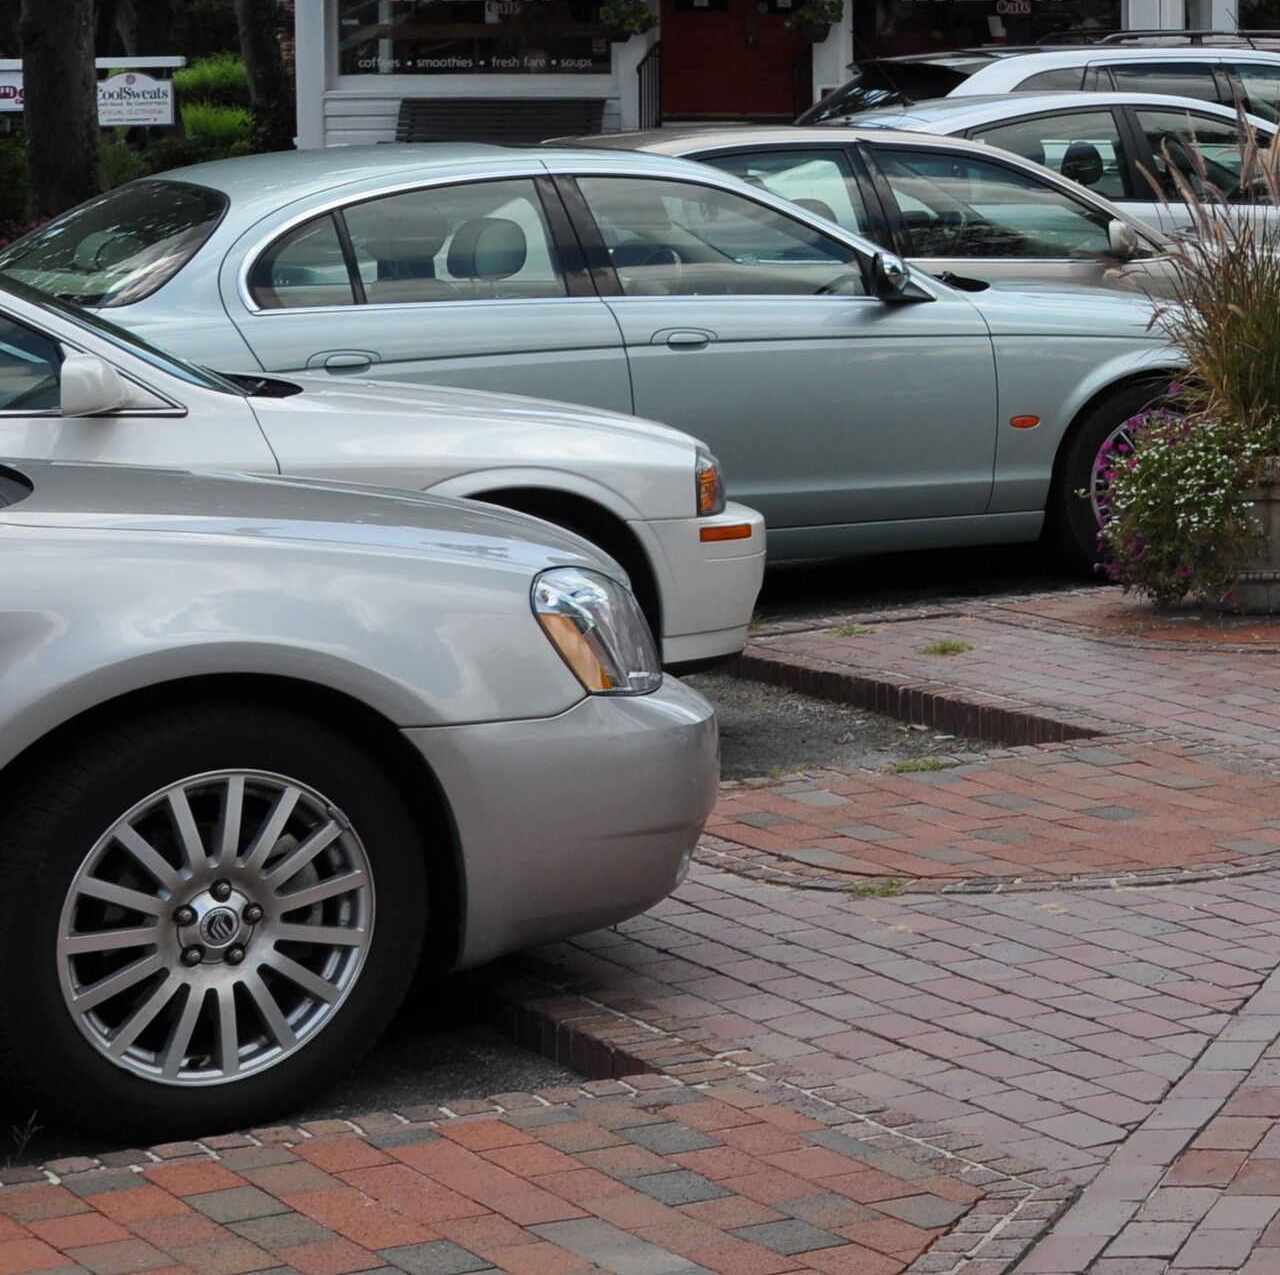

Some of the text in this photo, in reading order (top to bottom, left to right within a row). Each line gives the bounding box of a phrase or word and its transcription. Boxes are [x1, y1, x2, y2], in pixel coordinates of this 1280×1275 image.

[416, 56, 473, 68] smoothies
[491, 56, 519, 68] fresh
[523, 56, 546, 68] fare
[560, 57, 592, 69] soups
